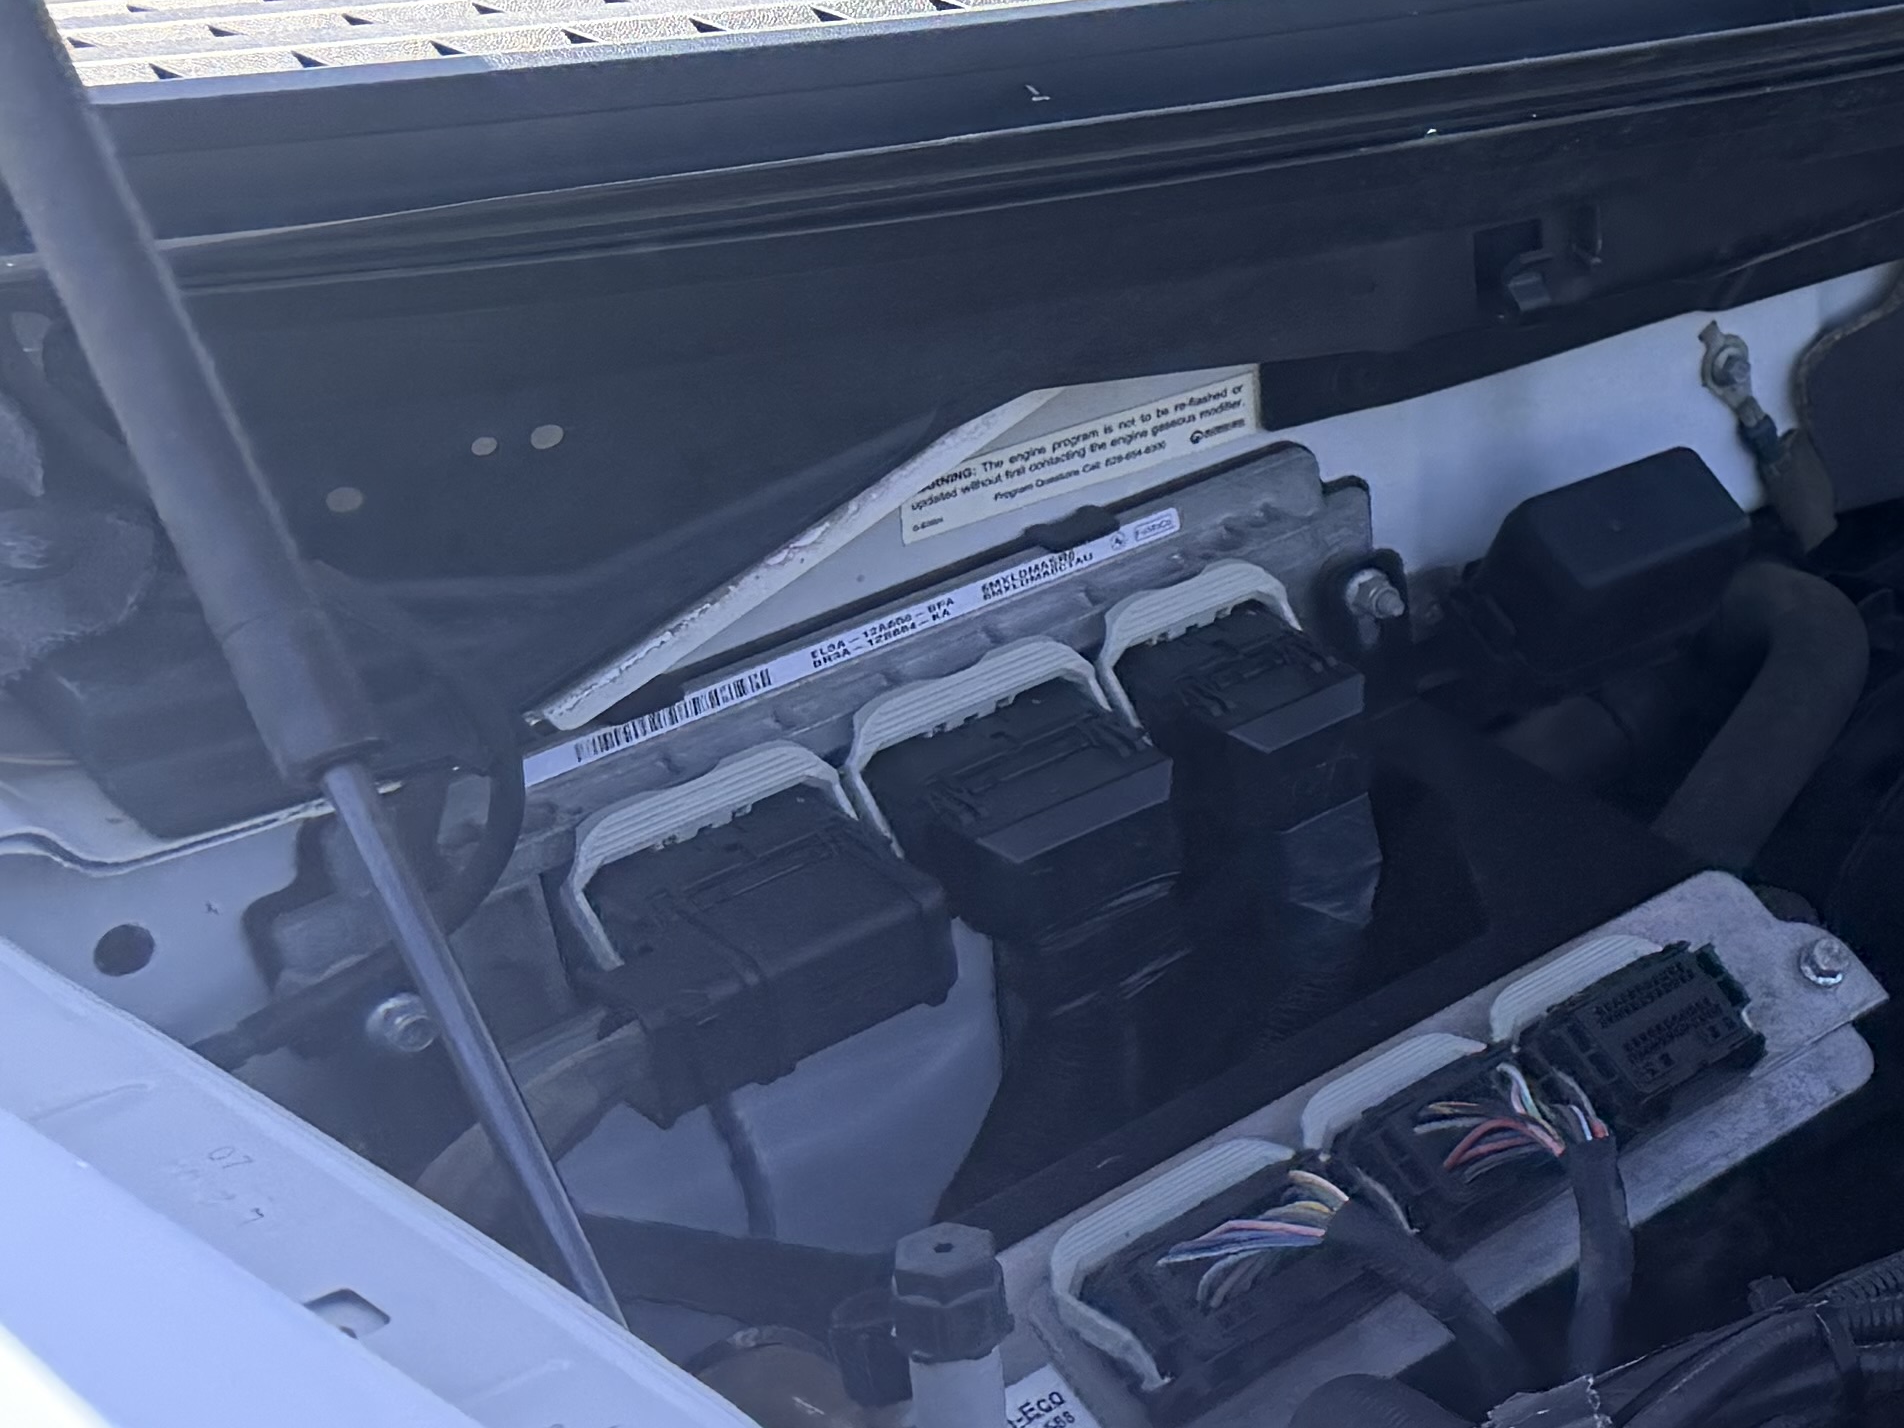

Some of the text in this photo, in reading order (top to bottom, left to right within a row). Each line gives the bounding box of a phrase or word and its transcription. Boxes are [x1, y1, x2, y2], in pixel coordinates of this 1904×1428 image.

[911, 487, 957, 512] updated
[960, 471, 1003, 496] without
[1004, 464, 1025, 480] first
[1028, 444, 1086, 475] contacting
[1089, 438, 1106, 453] the
[1110, 427, 1148, 450] engine
[981, 383, 1243, 473] The engine program is not to be re-flashed or
